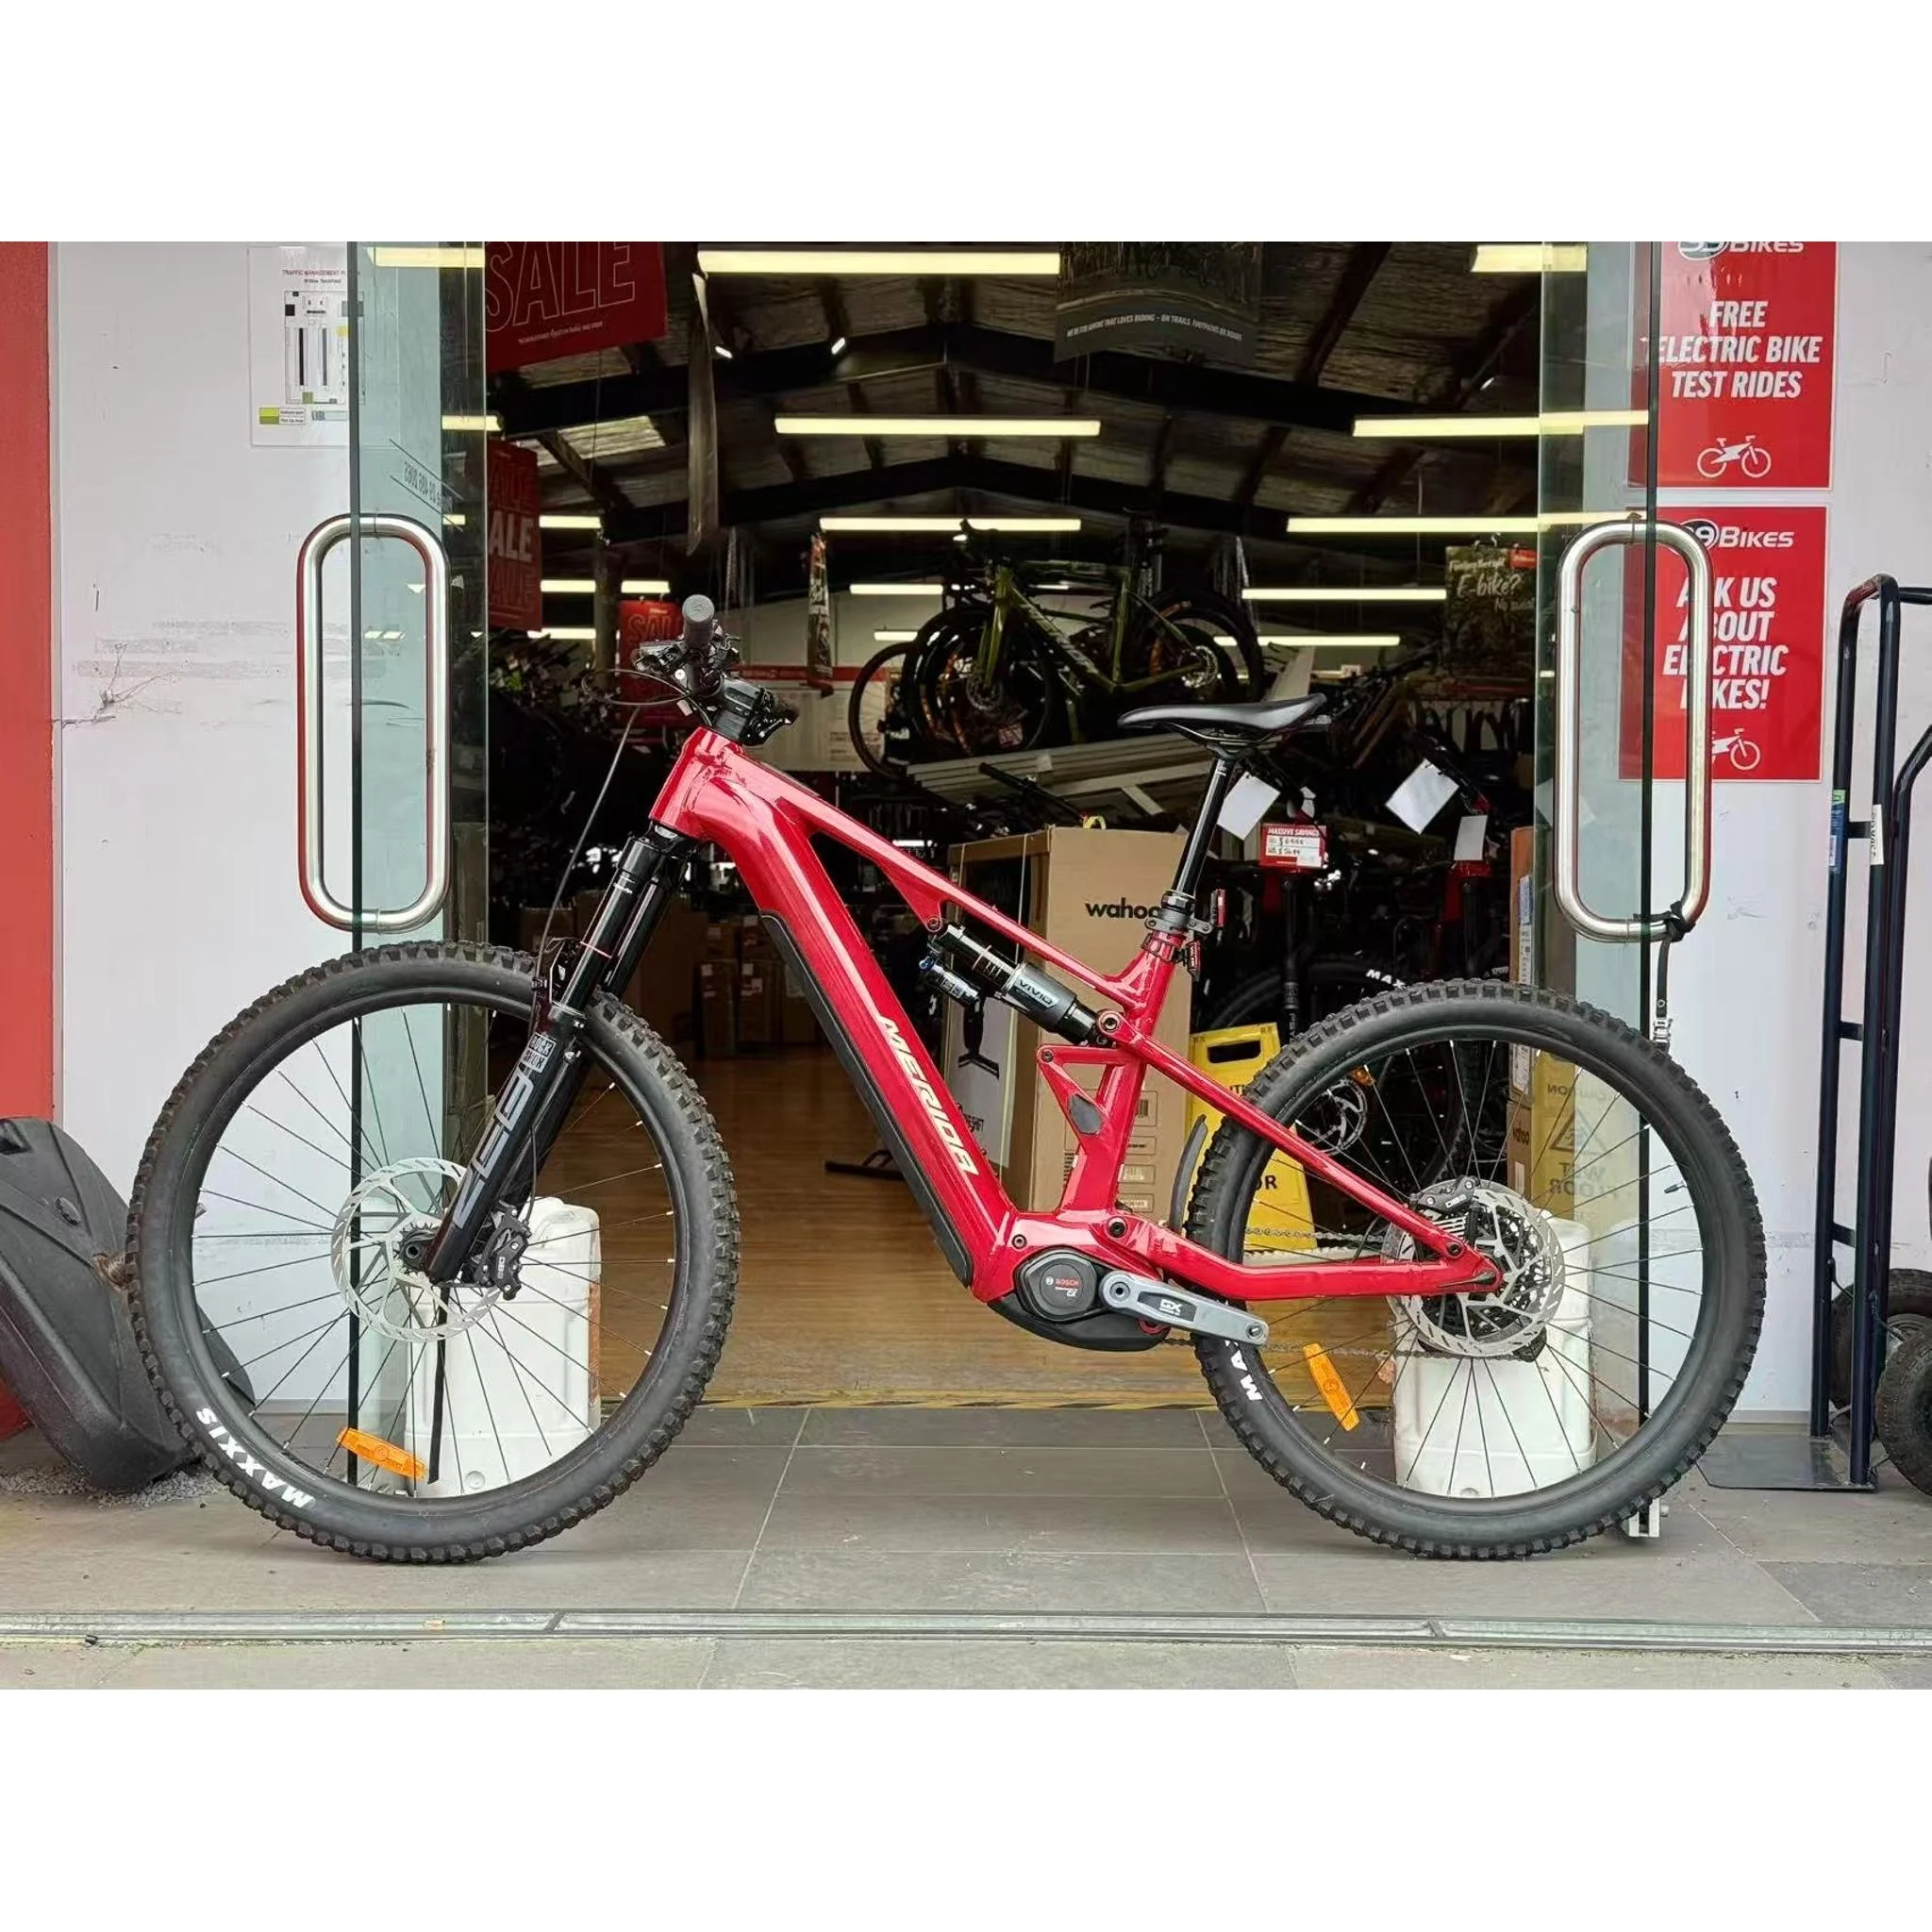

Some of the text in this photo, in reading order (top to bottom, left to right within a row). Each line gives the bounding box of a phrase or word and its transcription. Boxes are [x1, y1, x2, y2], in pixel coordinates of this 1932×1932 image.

[486, 242, 635, 332] SALE
[1117, 314, 1134, 325] LOVES
[1135, 313, 1156, 323] RIDING
[1708, 300, 1769, 328] FREE
[1765, 336, 1824, 363] BIKE
[1672, 370, 1803, 399] TEST RIDES
[489, 510, 535, 563] ALE
[1457, 572, 1522, 598] E-bike?
[1740, 576, 1777, 608] US
[1268, 826, 1321, 838] MASSIVE SAVINGS
[1019, 979, 1054, 1005] VIVID
[877, 1014, 979, 1176] MERIDA
[1055, 1277, 1080, 1289] BOSCH
[195, 1407, 316, 1509] MAXXIS
